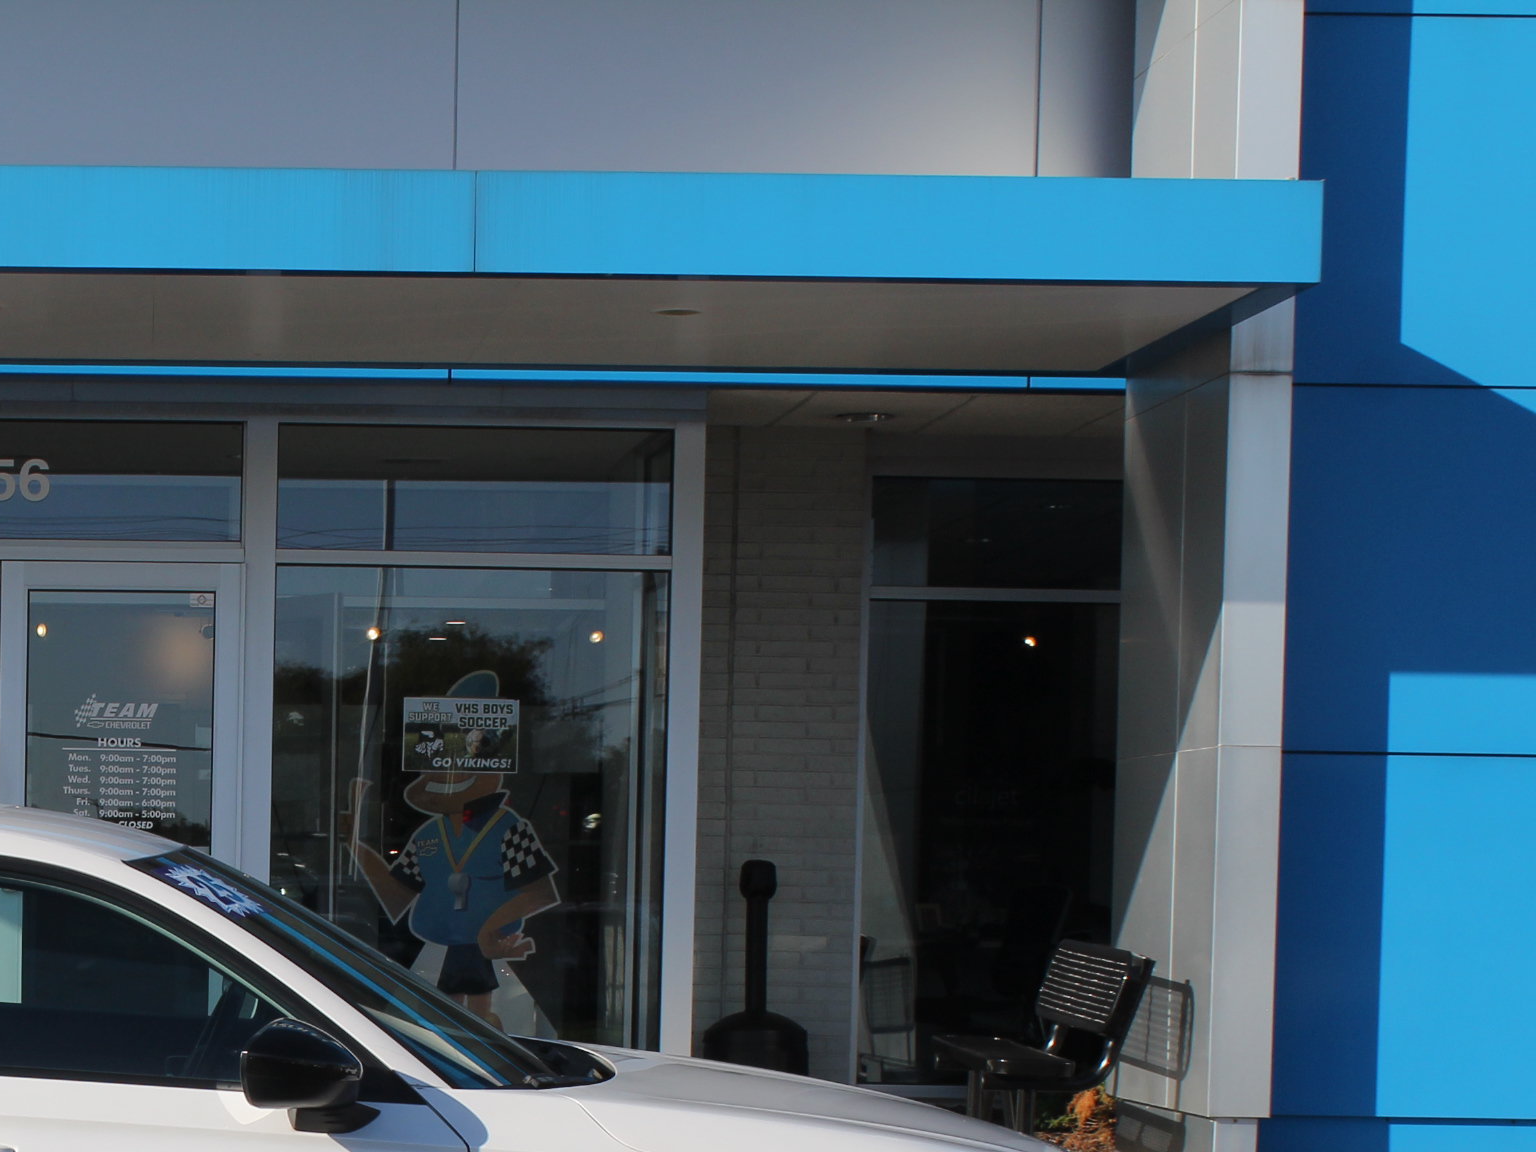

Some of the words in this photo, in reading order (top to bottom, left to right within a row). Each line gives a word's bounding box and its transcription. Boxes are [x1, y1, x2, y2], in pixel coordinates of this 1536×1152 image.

[90, 703, 158, 718] TEAM
[422, 702, 440, 711] WE
[455, 703, 479, 714] VHS
[483, 703, 514, 715] BOYS
[408, 712, 453, 722] SUPPORT
[458, 716, 509, 728] SOCCER
[105, 721, 151, 729] CHEVROLET
[97, 738, 142, 748] HOURS
[68, 753, 91, 762] Mon.
[99, 754, 134, 763] 9:00am
[142, 755, 177, 765] 7:00pm
[432, 757, 452, 768] GO
[456, 757, 512, 769] VIKINGS!
[68, 764, 91, 773] Tues.
[99, 765, 134, 774] 9:00am
[142, 766, 177, 776] 7:00pm
[68, 775, 91, 784] Wed.
[99, 776, 134, 785] 9:00am
[142, 777, 177, 787] 7:00pm
[63, 786, 91, 795] Thurs.
[99, 787, 134, 796] 9:00am
[141, 788, 176, 798] 7:00pm
[954, 783, 1018, 811] ciljet
[76, 797, 91, 806] Fri.
[99, 798, 134, 807] 9:00am
[141, 799, 176, 809] 6:00pm
[73, 808, 90, 817] Sat.
[99, 809, 134, 818] 9:00am
[141, 810, 176, 821] 5:00pm
[118, 821, 154, 830] CLOSED
